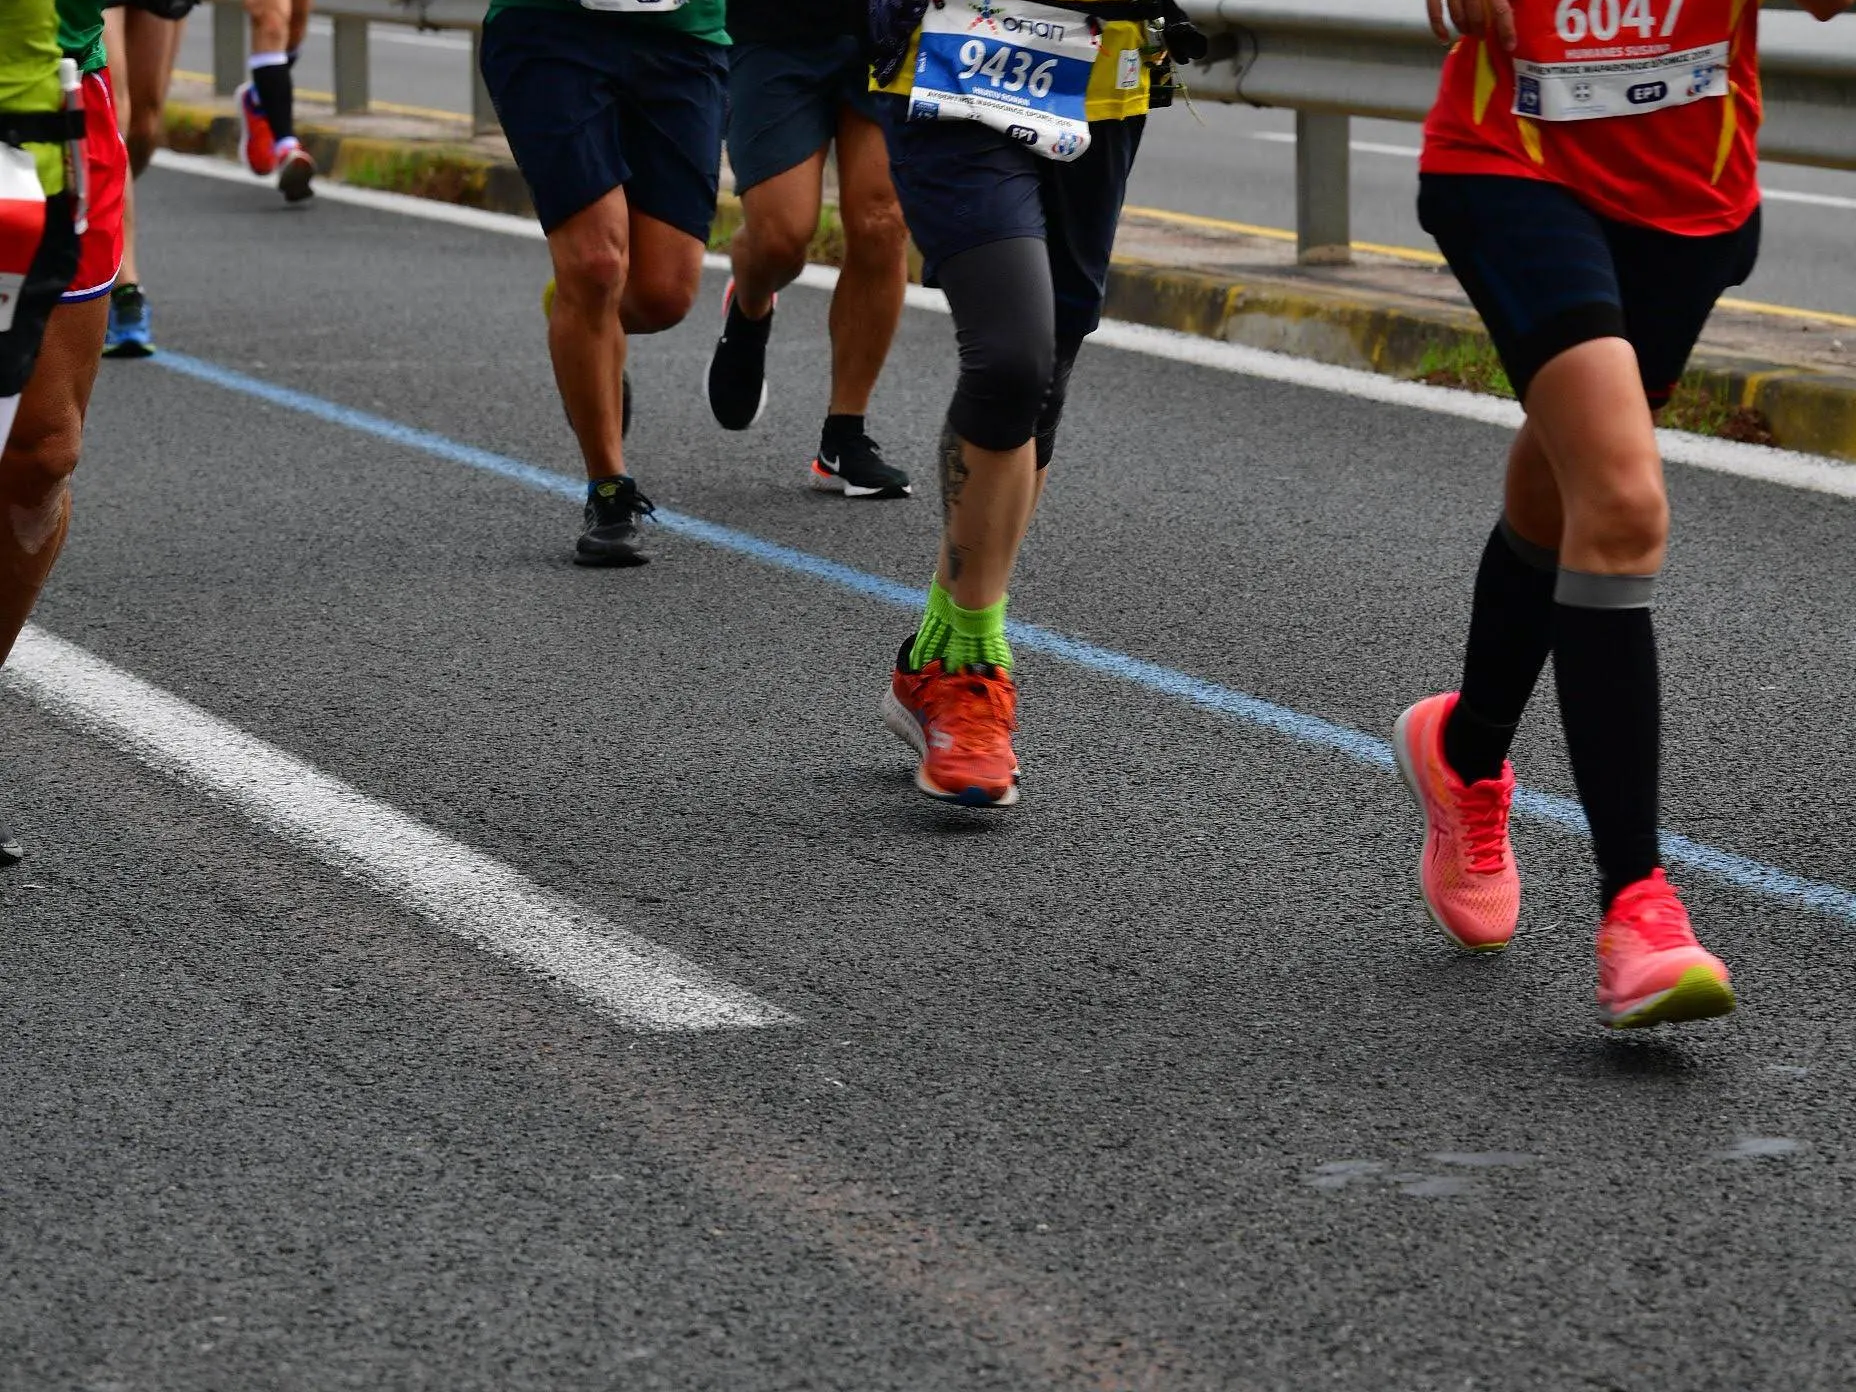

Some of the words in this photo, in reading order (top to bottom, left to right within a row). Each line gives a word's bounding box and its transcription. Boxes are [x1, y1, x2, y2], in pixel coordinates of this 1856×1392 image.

[957, 39, 1059, 99] 9436
[1633, 84, 1662, 101] ΕΡΤ
[1010, 127, 1035, 143] ΕΡΤ
